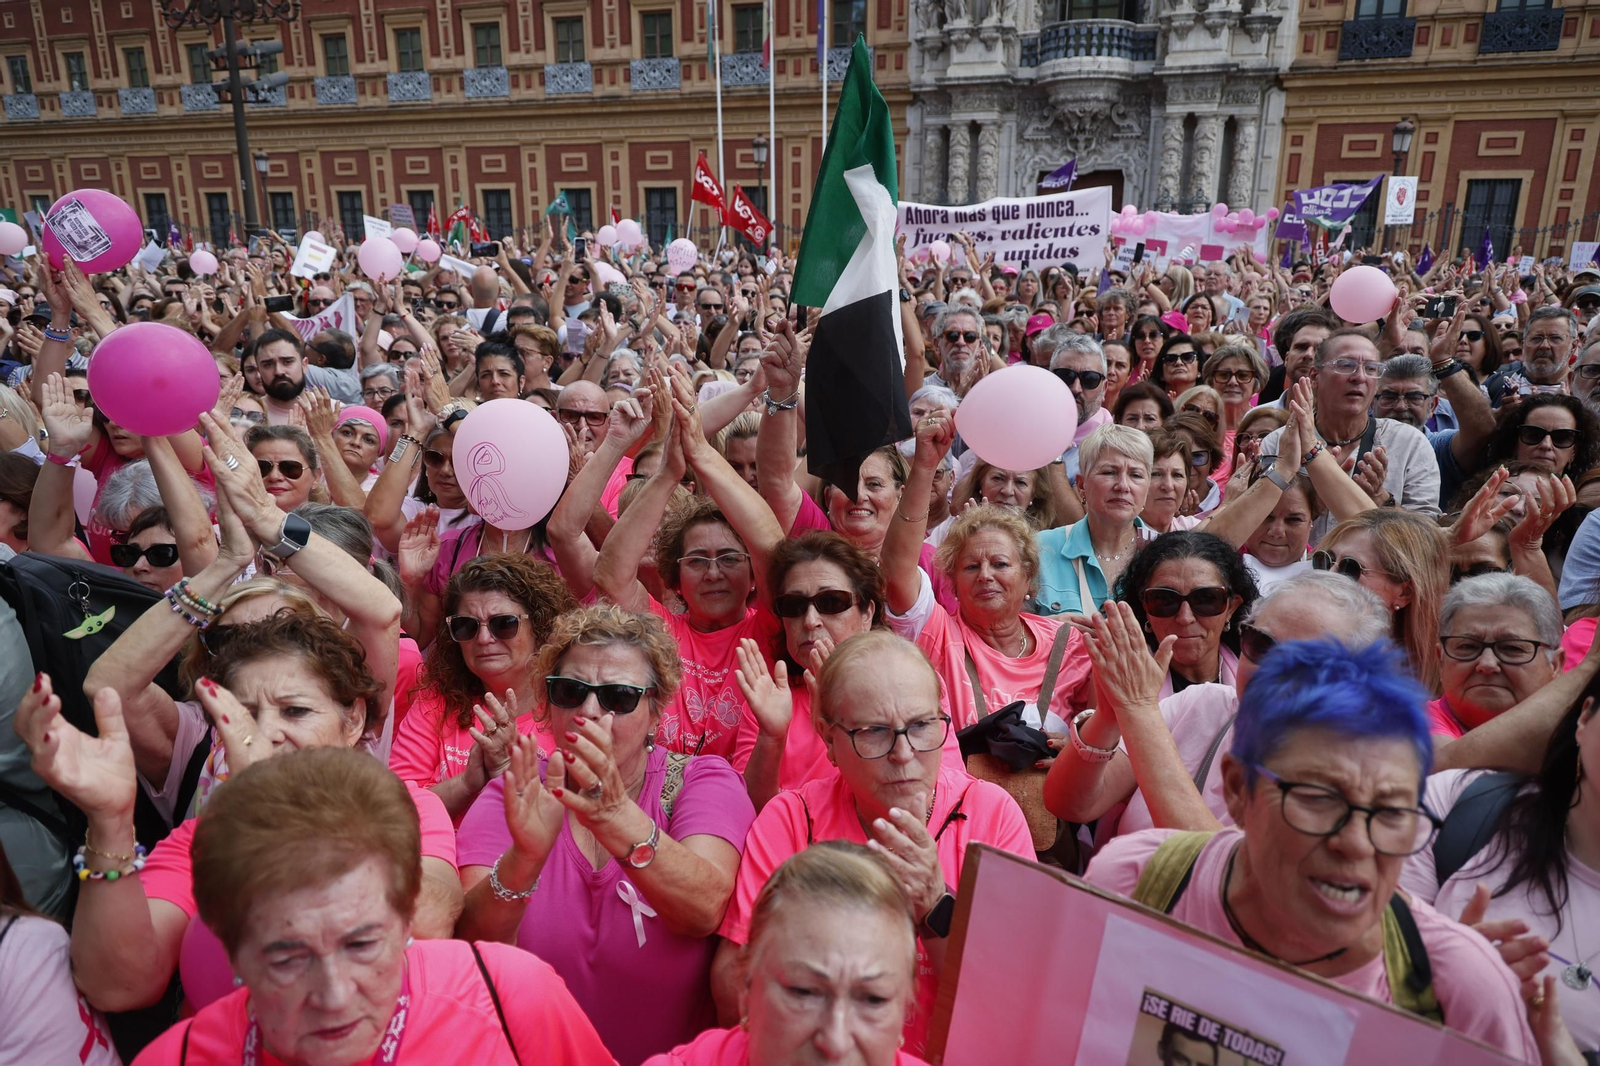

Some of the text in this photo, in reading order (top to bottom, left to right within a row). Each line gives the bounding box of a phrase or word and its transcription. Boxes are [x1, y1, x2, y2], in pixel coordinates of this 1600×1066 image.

[695, 165, 720, 196] UGT
[734, 195, 757, 225] UGT
[905, 206, 949, 225] Ahora
[991, 205, 1020, 224] que
[1026, 199, 1089, 220] nunca...
[1000, 221, 1100, 242] valientes
[1003, 243, 1080, 262] unidas
[1142, 994, 1282, 1066] ¡SE RIE DE TODAS!
